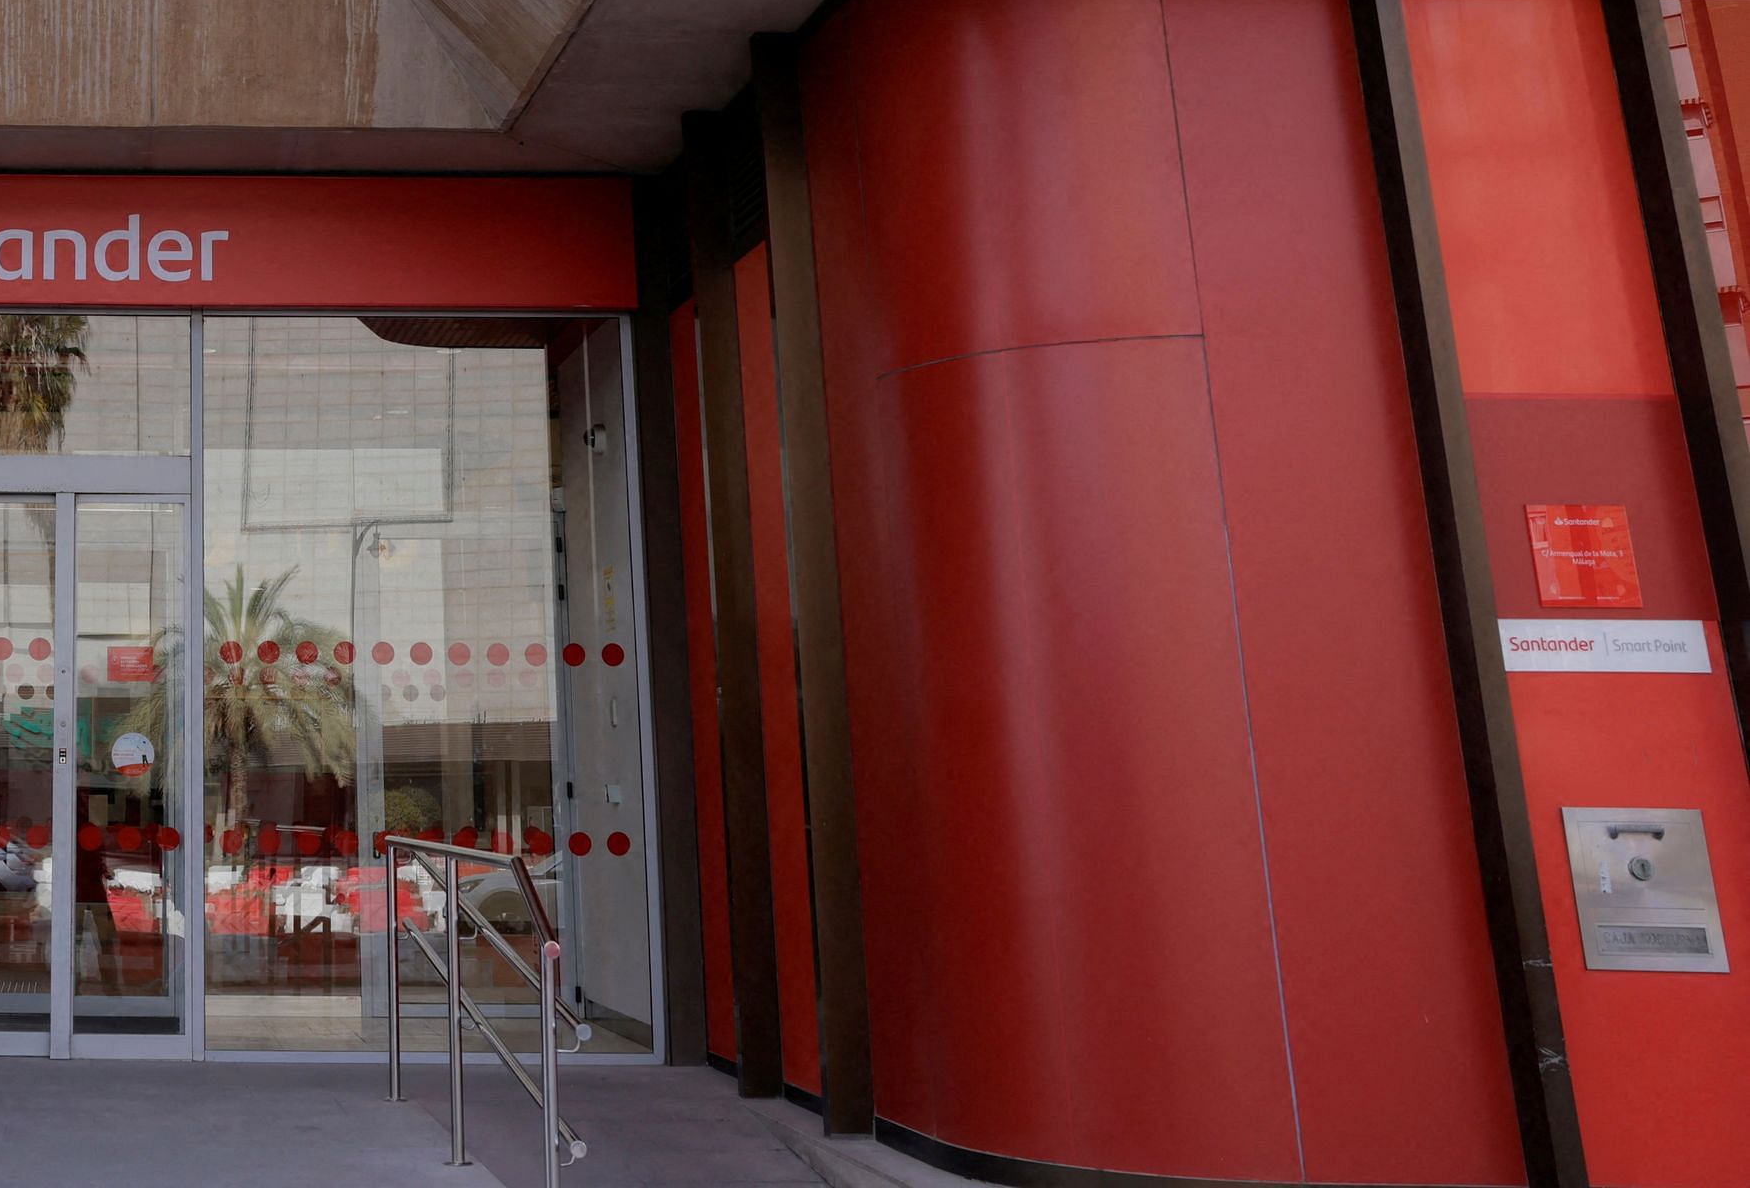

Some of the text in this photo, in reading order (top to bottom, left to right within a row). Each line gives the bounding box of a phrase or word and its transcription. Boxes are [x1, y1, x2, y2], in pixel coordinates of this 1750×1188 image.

[1564, 517, 1600, 526] Santander
[1509, 637, 1688, 653] Santander Smart Point
